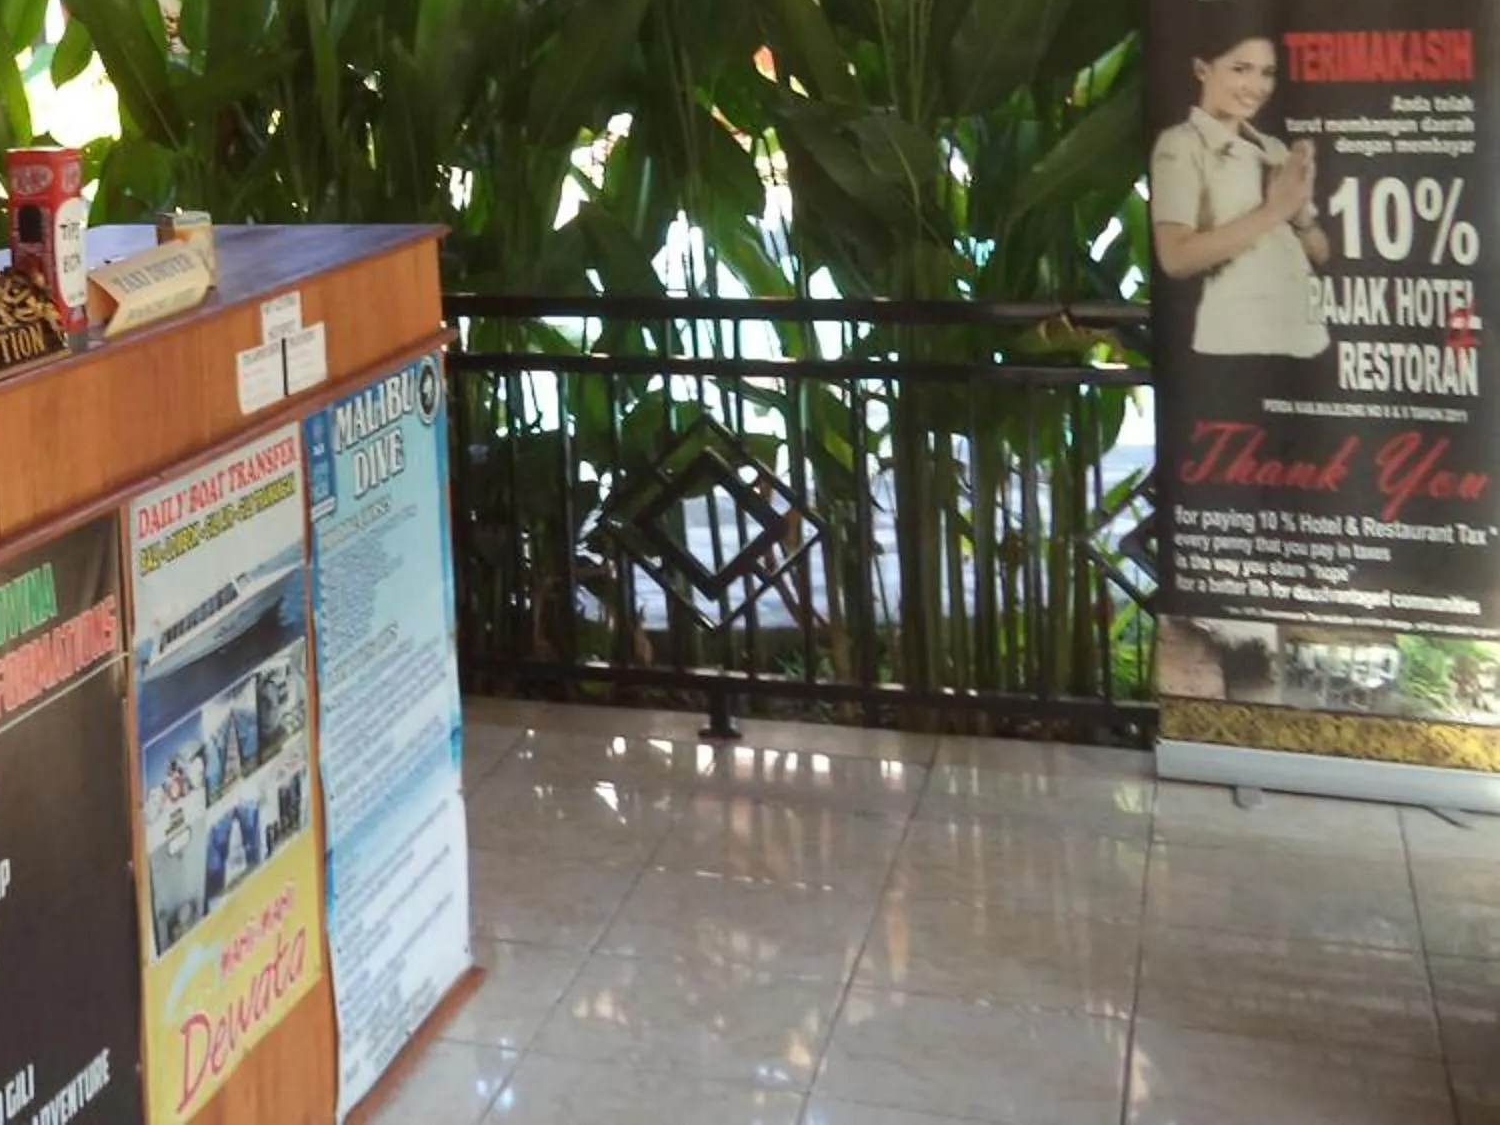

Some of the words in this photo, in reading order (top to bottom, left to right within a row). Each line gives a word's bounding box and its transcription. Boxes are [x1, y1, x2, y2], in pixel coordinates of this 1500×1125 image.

[1283, 28, 1475, 82] TERIMAKASIH
[1328, 176, 1480, 266] 10%
[1307, 275, 1390, 325] PAJAK
[1395, 277, 1483, 330] HOTEL
[1338, 340, 1479, 396] RESTORAN
[334, 367, 416, 455] MALIBU
[137, 489, 188, 540] DAILY
[189, 471, 227, 513] BOAT
[227, 436, 298, 493] TRANSFER
[353, 426, 405, 500] DIVE
[1180, 420, 1361, 492] Thank
[1374, 430, 1490, 523] You
[1174, 504, 1199, 526] for
[1201, 507, 1256, 534] paying
[1257, 509, 1278, 530] 10
[1299, 512, 1343, 536] Hotel
[1344, 515, 1360, 537] &
[1361, 516, 1456, 544] Restaurant
[1454, 523, 1488, 546] Tax
[31, 1047, 111, 1125] DVENTURE
